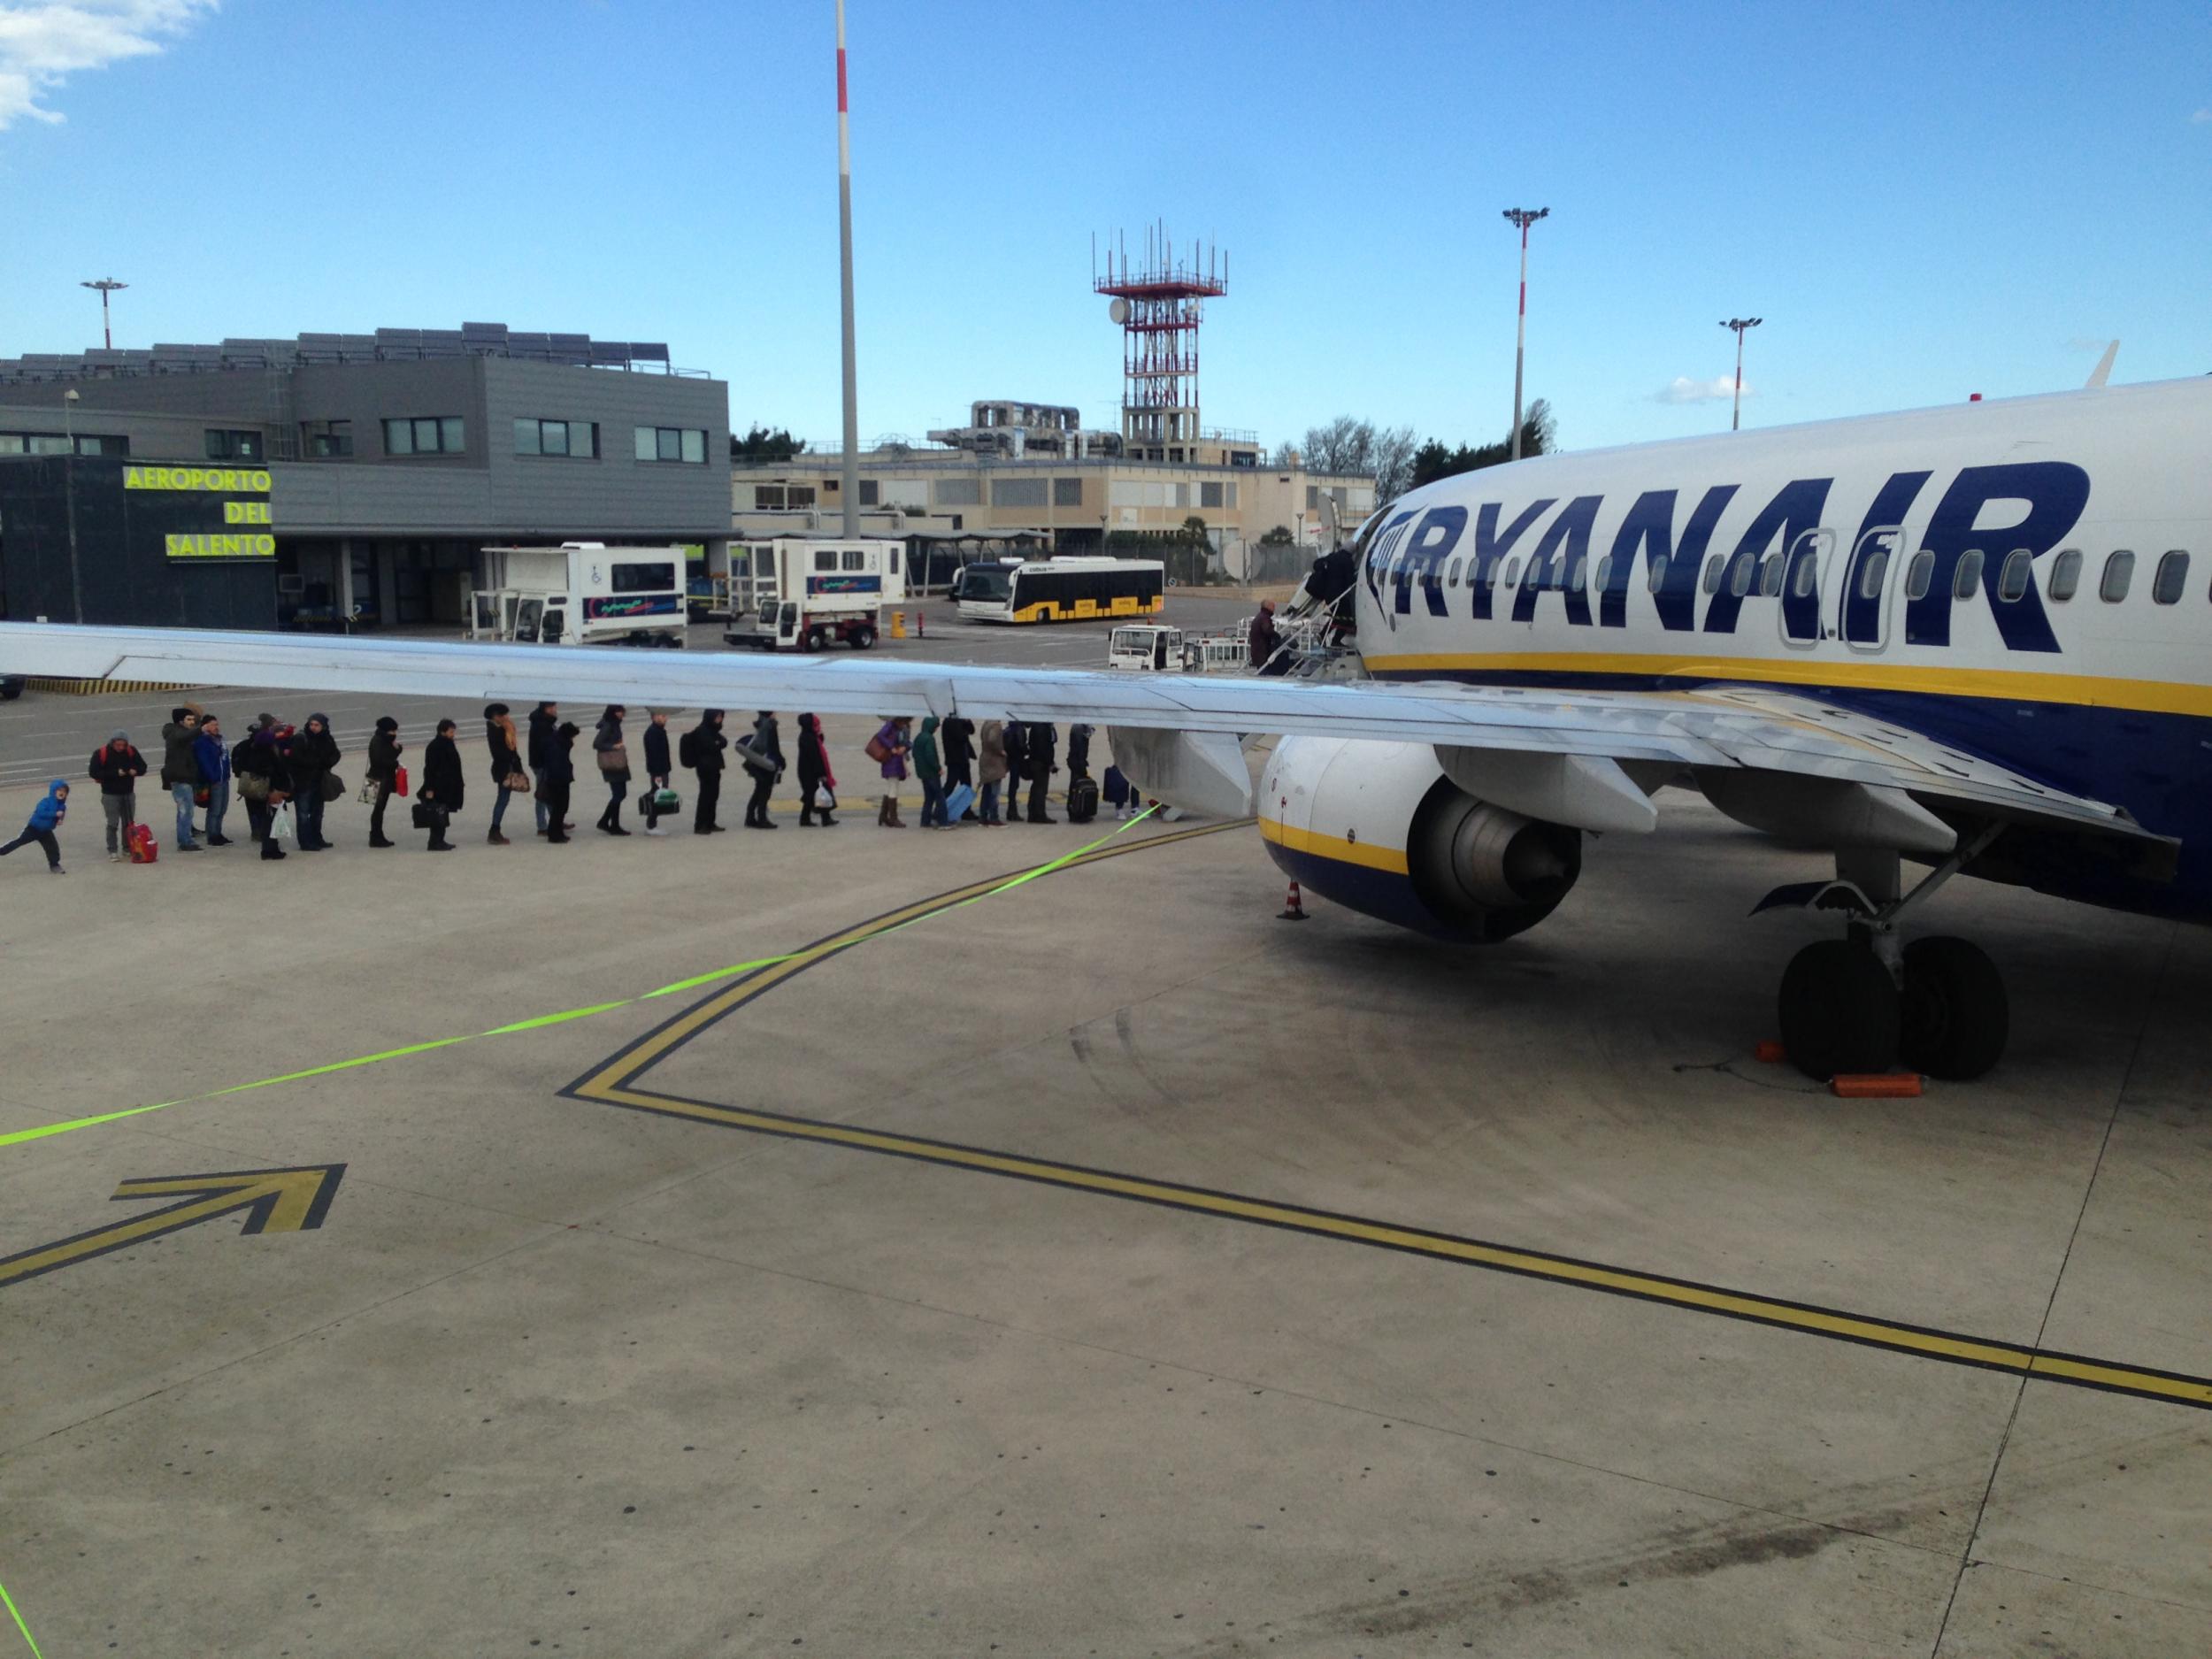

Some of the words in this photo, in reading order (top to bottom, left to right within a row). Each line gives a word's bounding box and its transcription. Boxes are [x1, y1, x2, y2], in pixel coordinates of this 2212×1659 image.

[127, 466, 272, 492] AEROPORTO
[226, 502, 271, 524] DEL
[165, 534, 276, 557] SALENTO
[1394, 460, 2091, 654] RYANAIR
